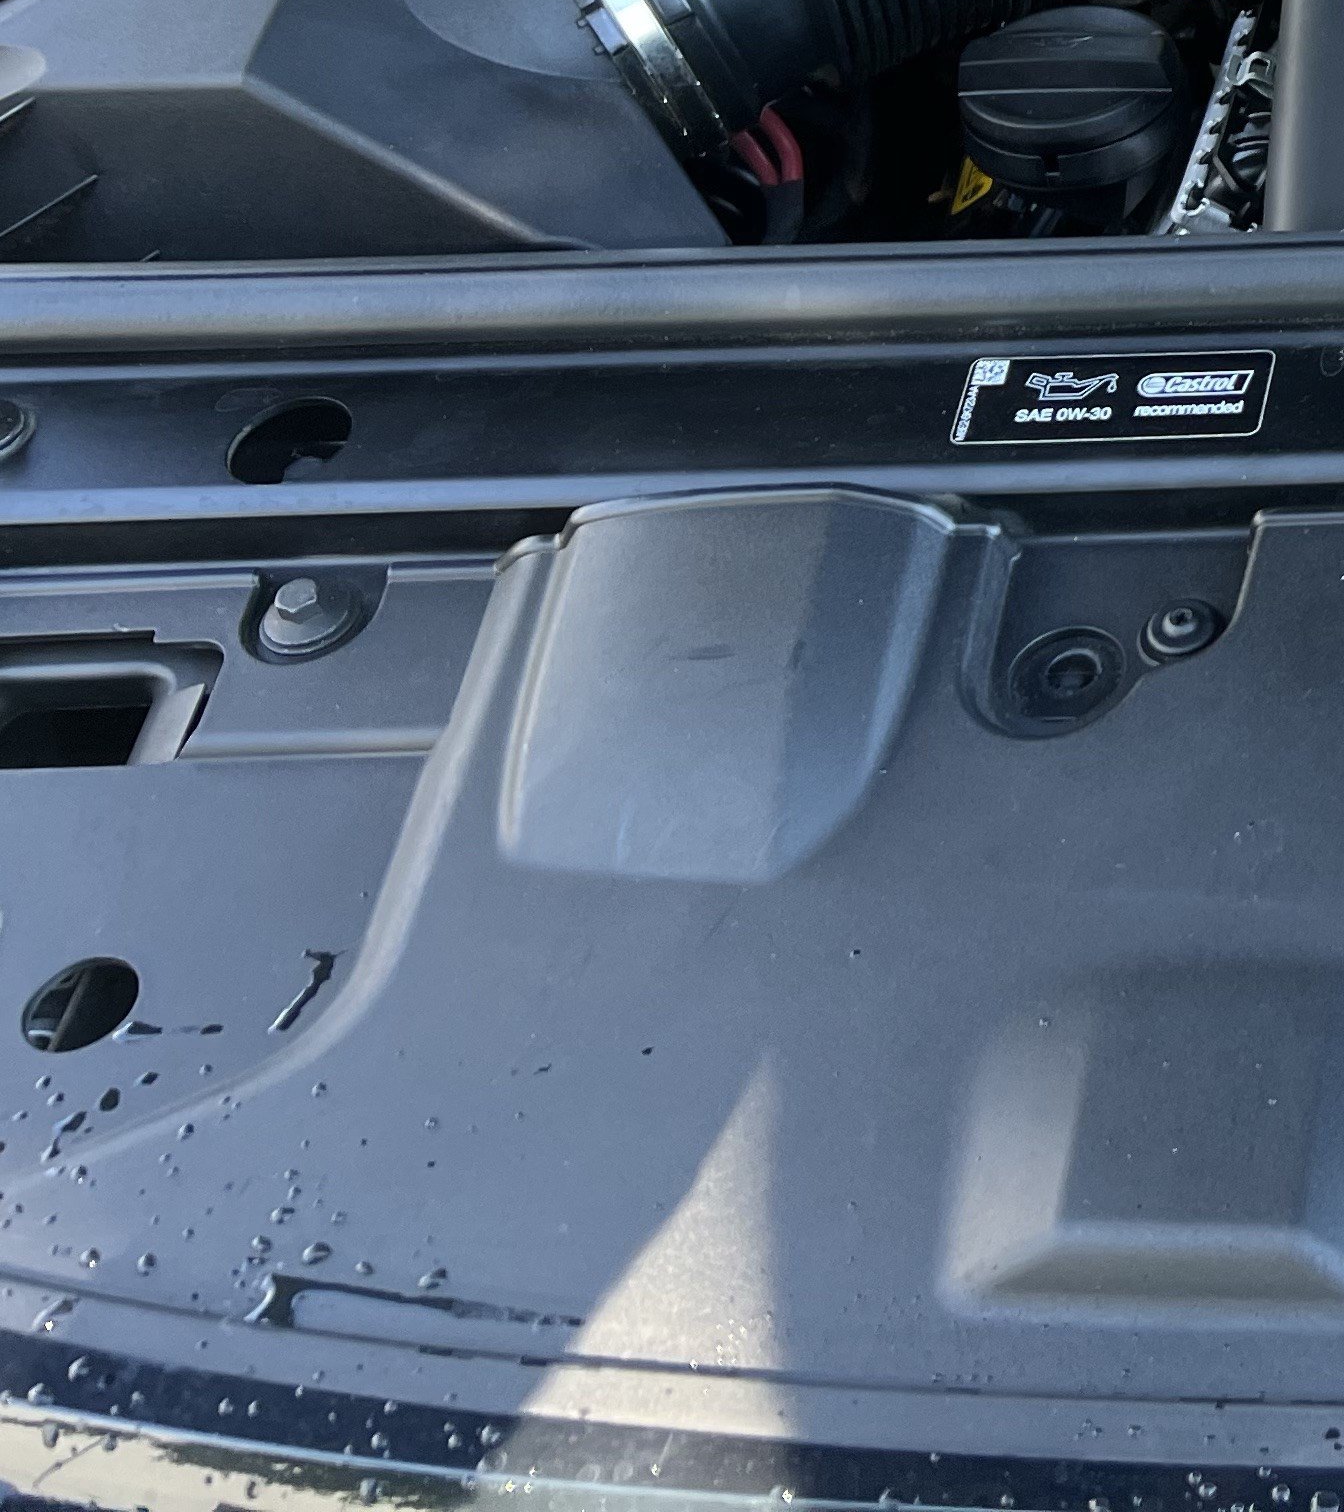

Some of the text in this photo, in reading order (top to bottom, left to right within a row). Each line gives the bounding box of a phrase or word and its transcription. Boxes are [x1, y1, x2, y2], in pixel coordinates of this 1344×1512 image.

[1164, 373, 1239, 393] Castrol
[1014, 406, 1113, 423] SAE 0W-30
[1133, 400, 1245, 417] recommended
